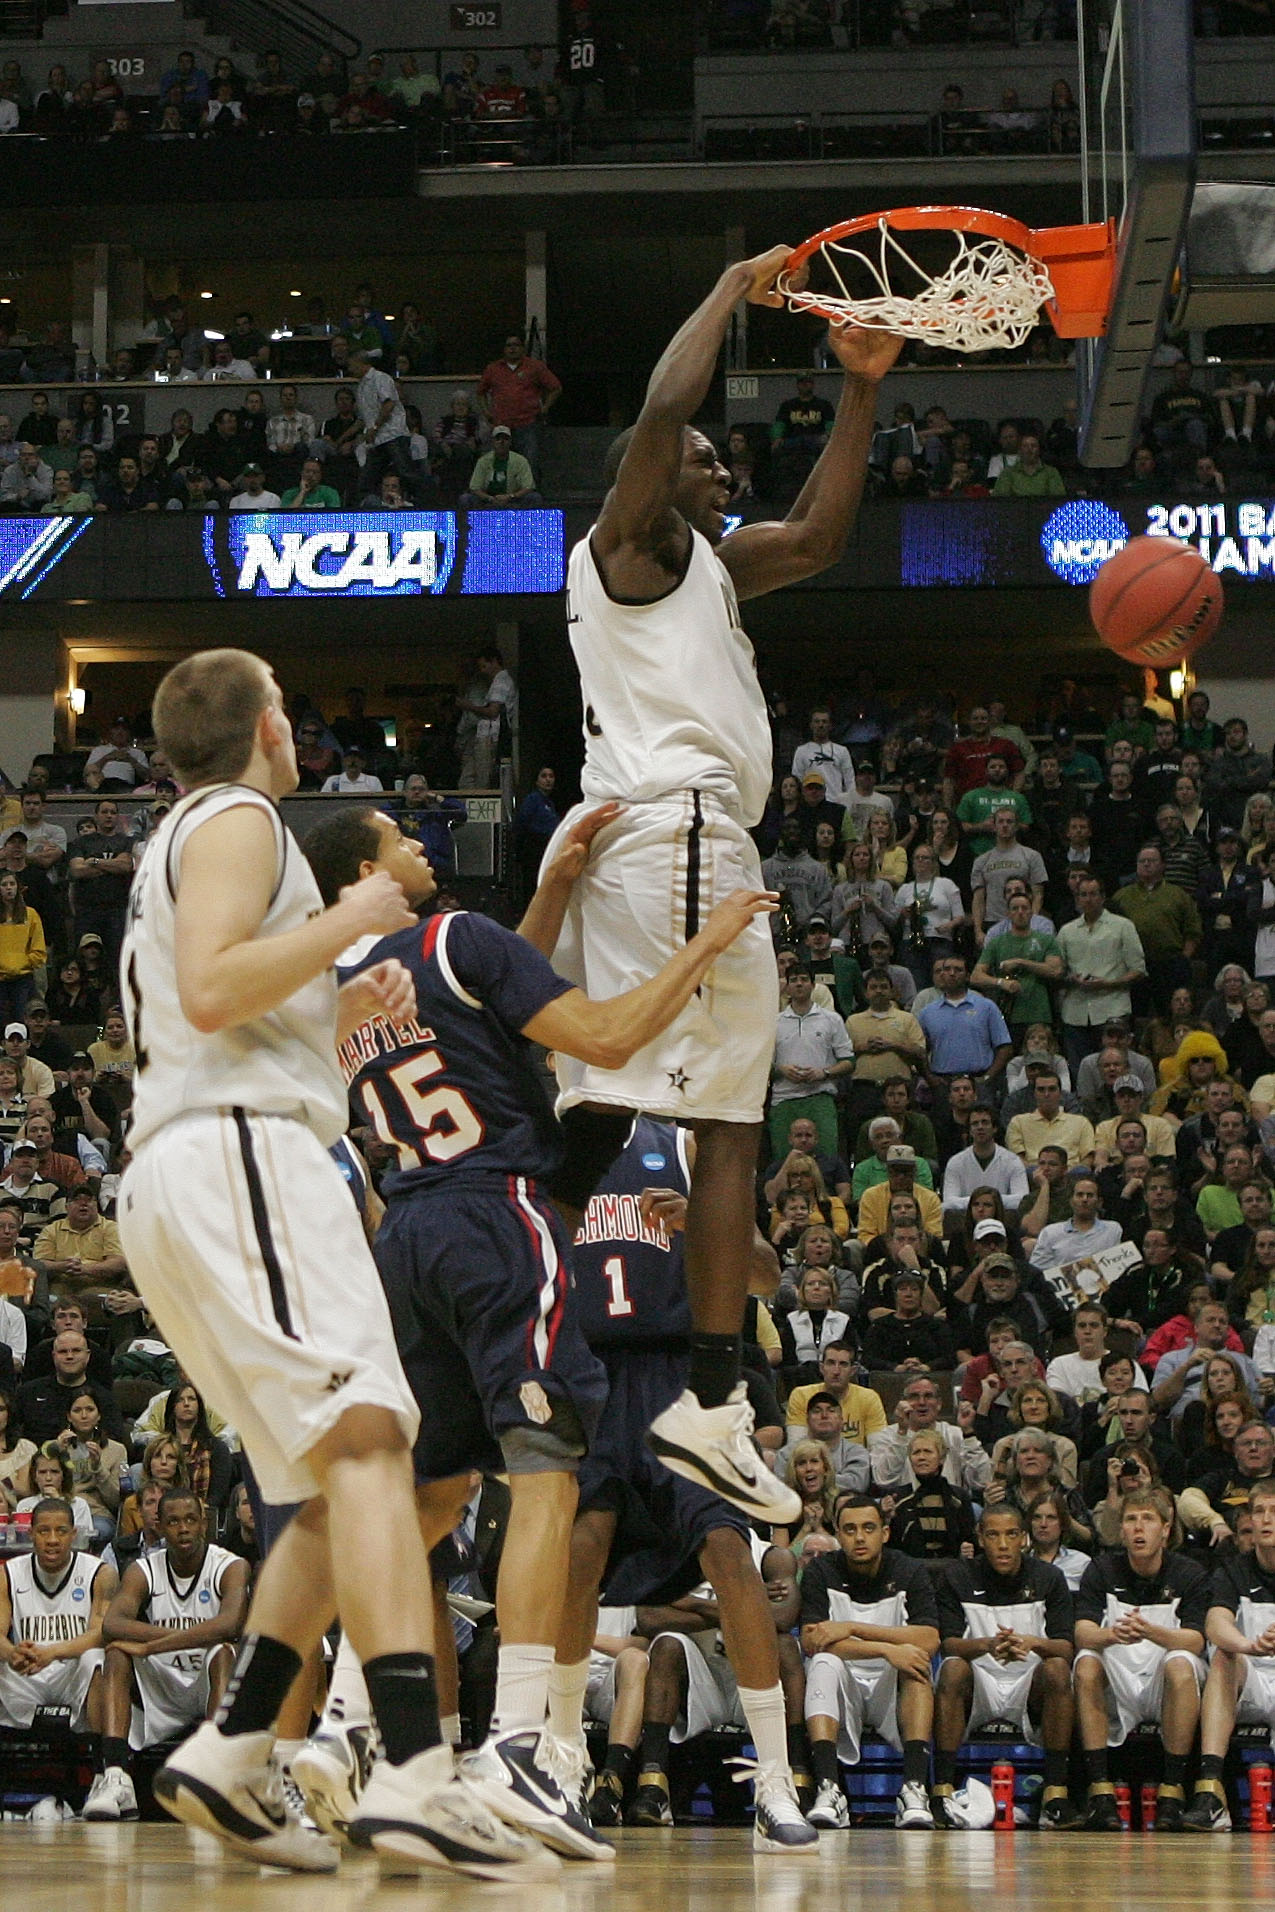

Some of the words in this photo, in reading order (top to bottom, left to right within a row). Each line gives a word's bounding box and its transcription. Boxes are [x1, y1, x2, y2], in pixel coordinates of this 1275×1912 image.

[465, 12, 497, 26] 302
[570, 43, 595, 70] 20
[728, 379, 756, 397] EXIT
[1147, 504, 1226, 537] 2011
[237, 531, 436, 590] NCAA
[469, 800, 499, 820] EXIT
[360, 1048, 486, 1172] 15
[603, 1255, 637, 1318] 1
[172, 1654, 203, 1672] 45
